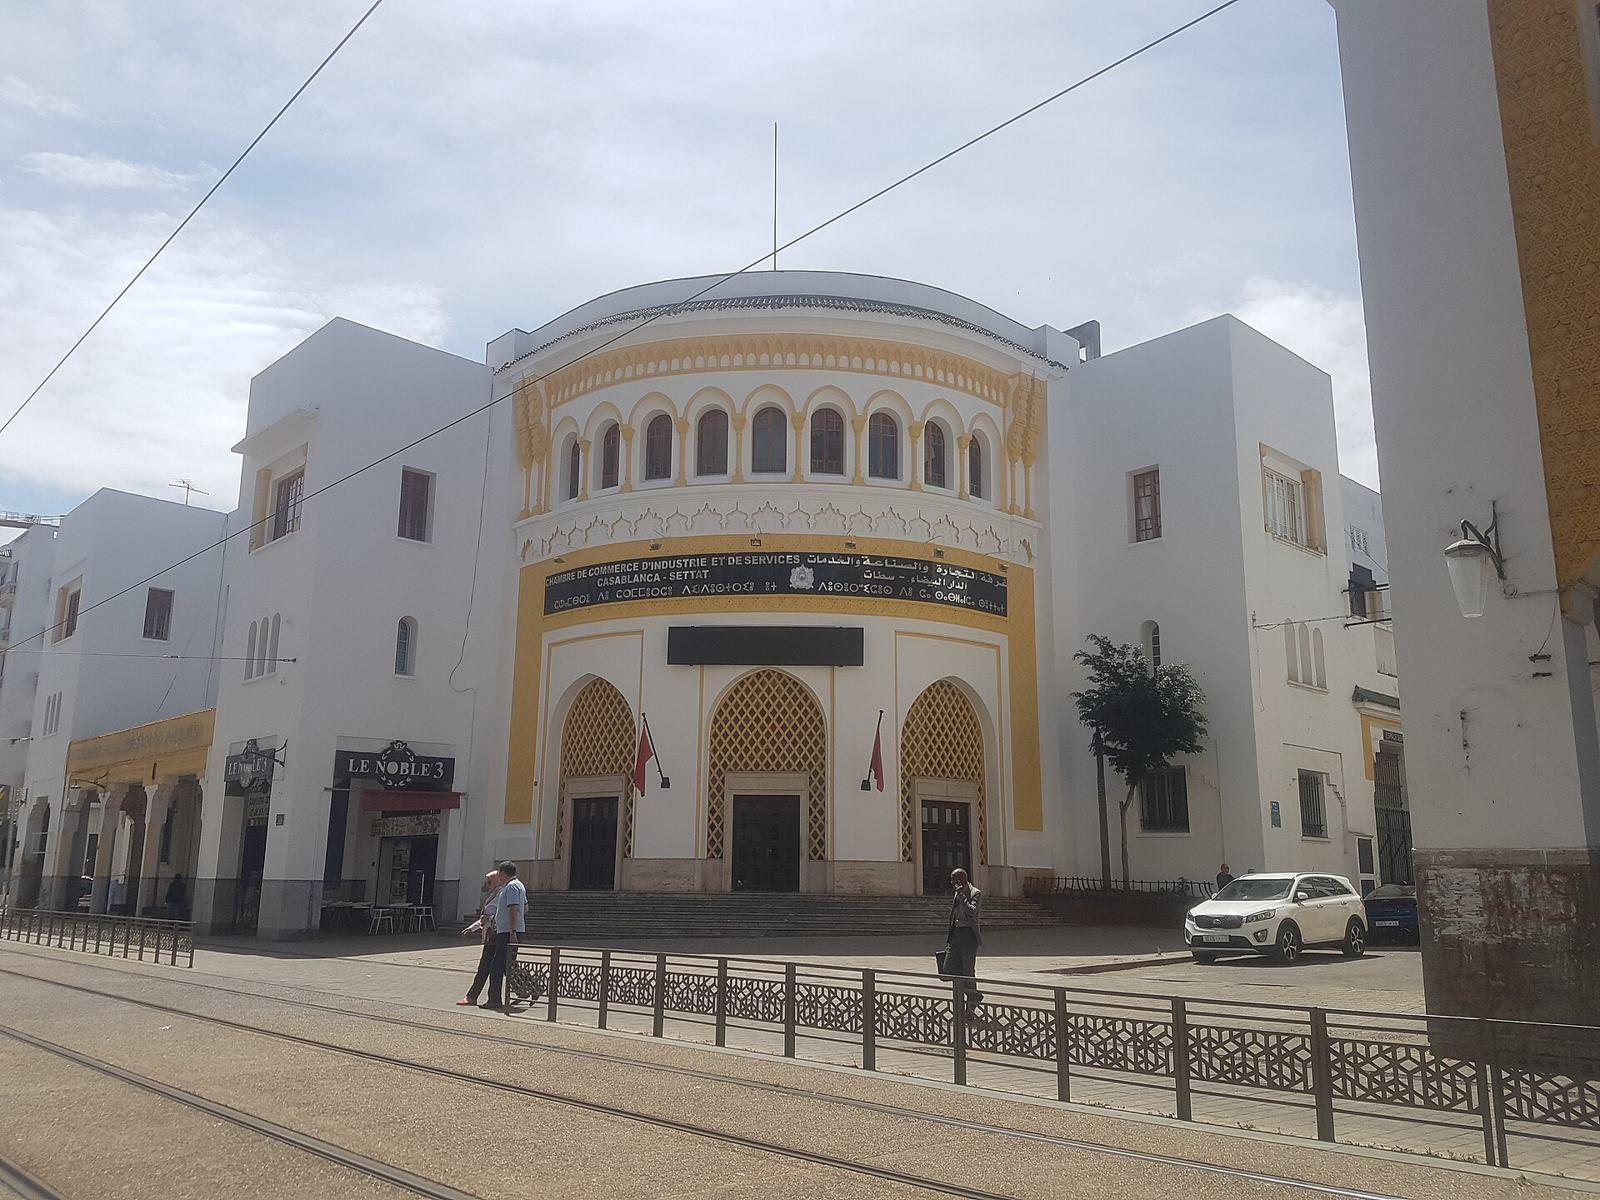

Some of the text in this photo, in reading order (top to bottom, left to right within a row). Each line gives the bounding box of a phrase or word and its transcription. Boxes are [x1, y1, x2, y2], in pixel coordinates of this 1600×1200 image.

[546, 555, 800, 588] CHAMBRE DE COMMERCE D'INDUSTRIE ET DE SERVICES
[597, 573, 660, 587] CASABLANCA
[669, 570, 709, 580] SETTAT
[807, 555, 1008, 588] غرفة التجارة والصناعة والخدمات
[863, 569, 895, 582] سطات
[910, 575, 946, 590] البيضاء
[946, 577, 968, 591] الدار
[348, 758, 370, 773] LE
